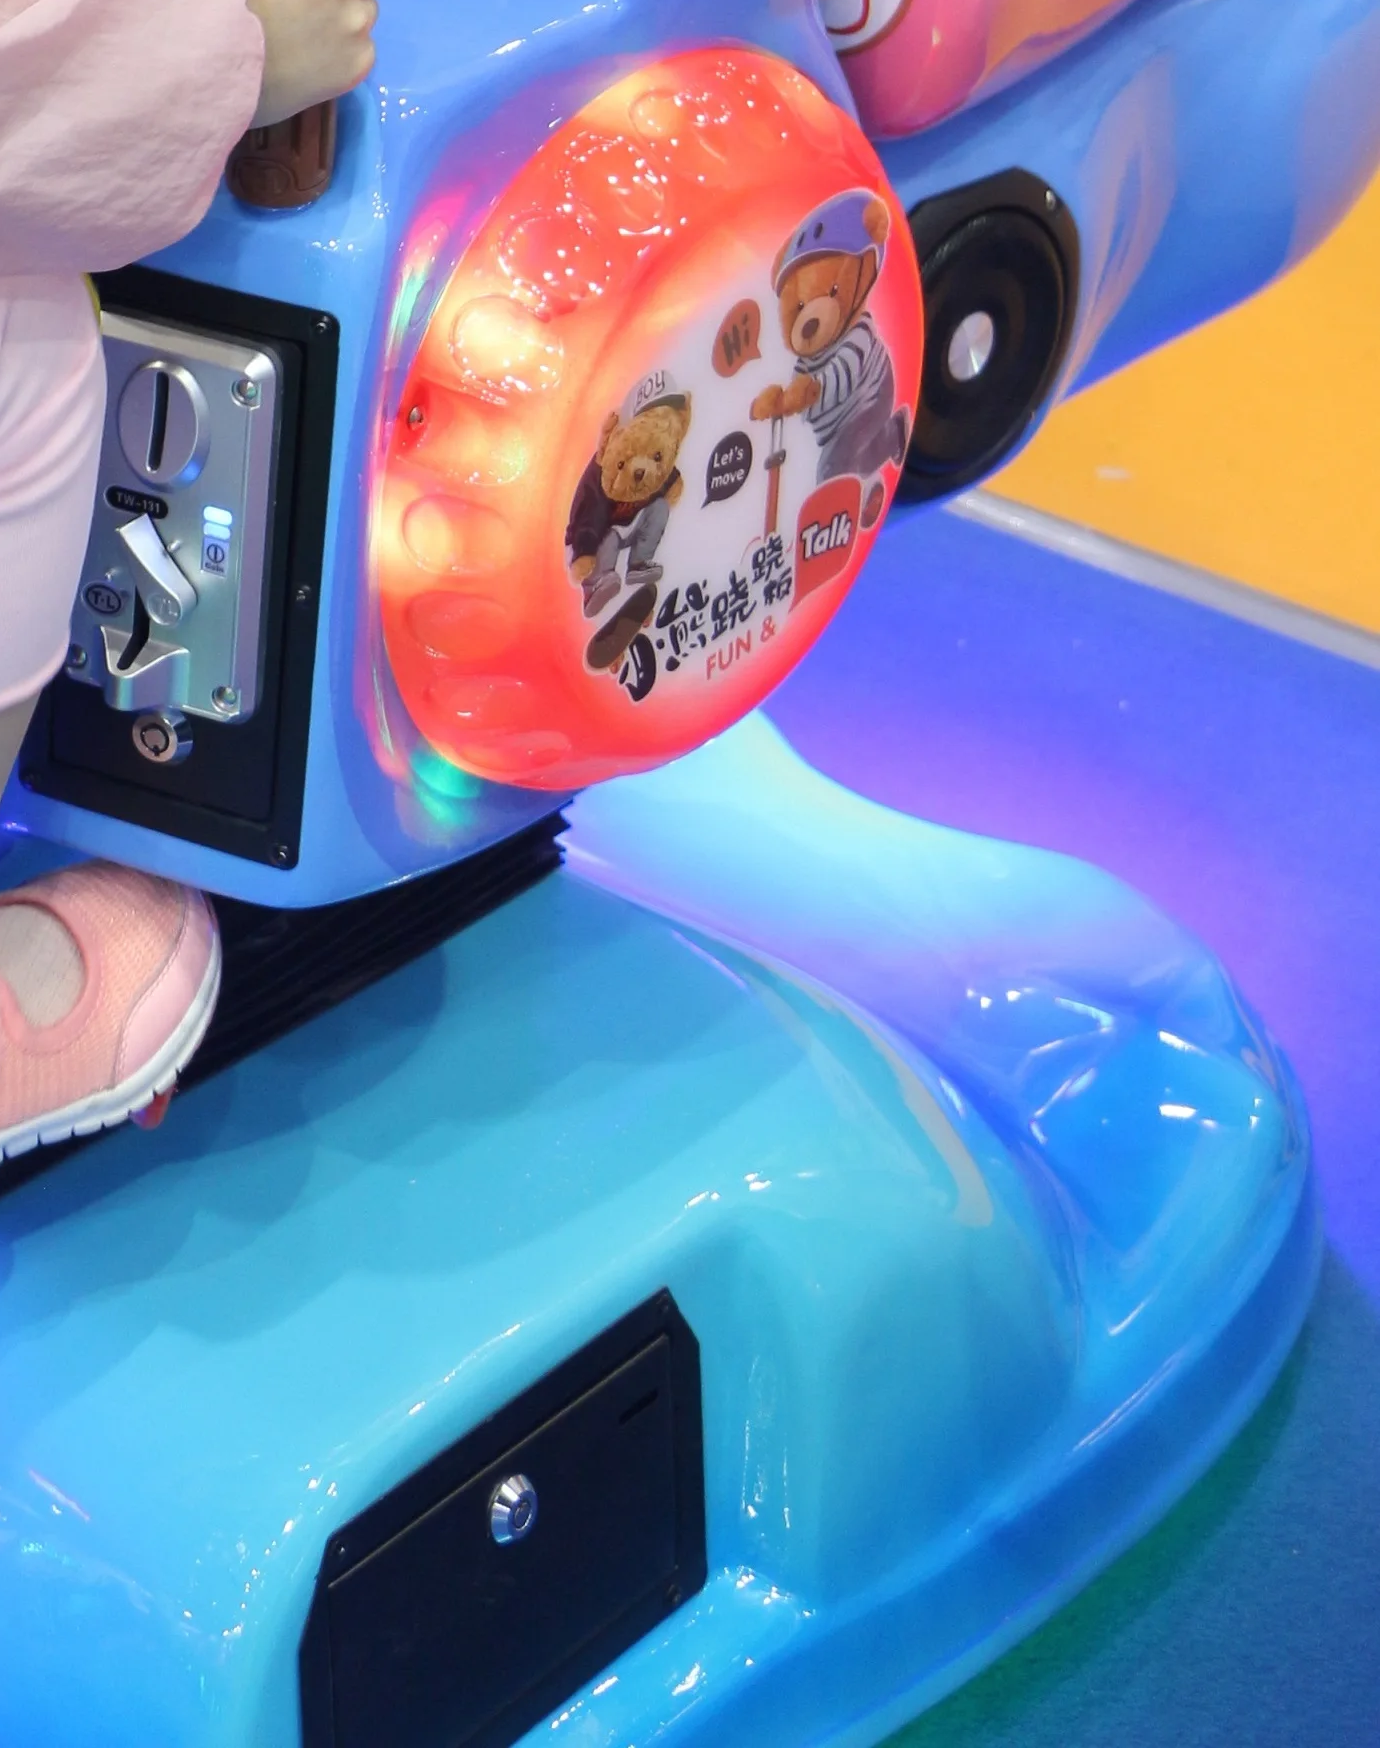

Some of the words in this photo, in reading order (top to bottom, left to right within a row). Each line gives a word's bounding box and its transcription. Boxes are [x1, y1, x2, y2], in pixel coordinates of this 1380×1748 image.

[722, 312, 751, 367] Hi
[636, 369, 666, 405] BOY
[713, 445, 744, 469] Let's
[711, 467, 745, 489] move
[116, 491, 161, 514] TW-131
[801, 510, 852, 561] Talk
[705, 629, 753, 681] FUN
[759, 615, 777, 643] &
